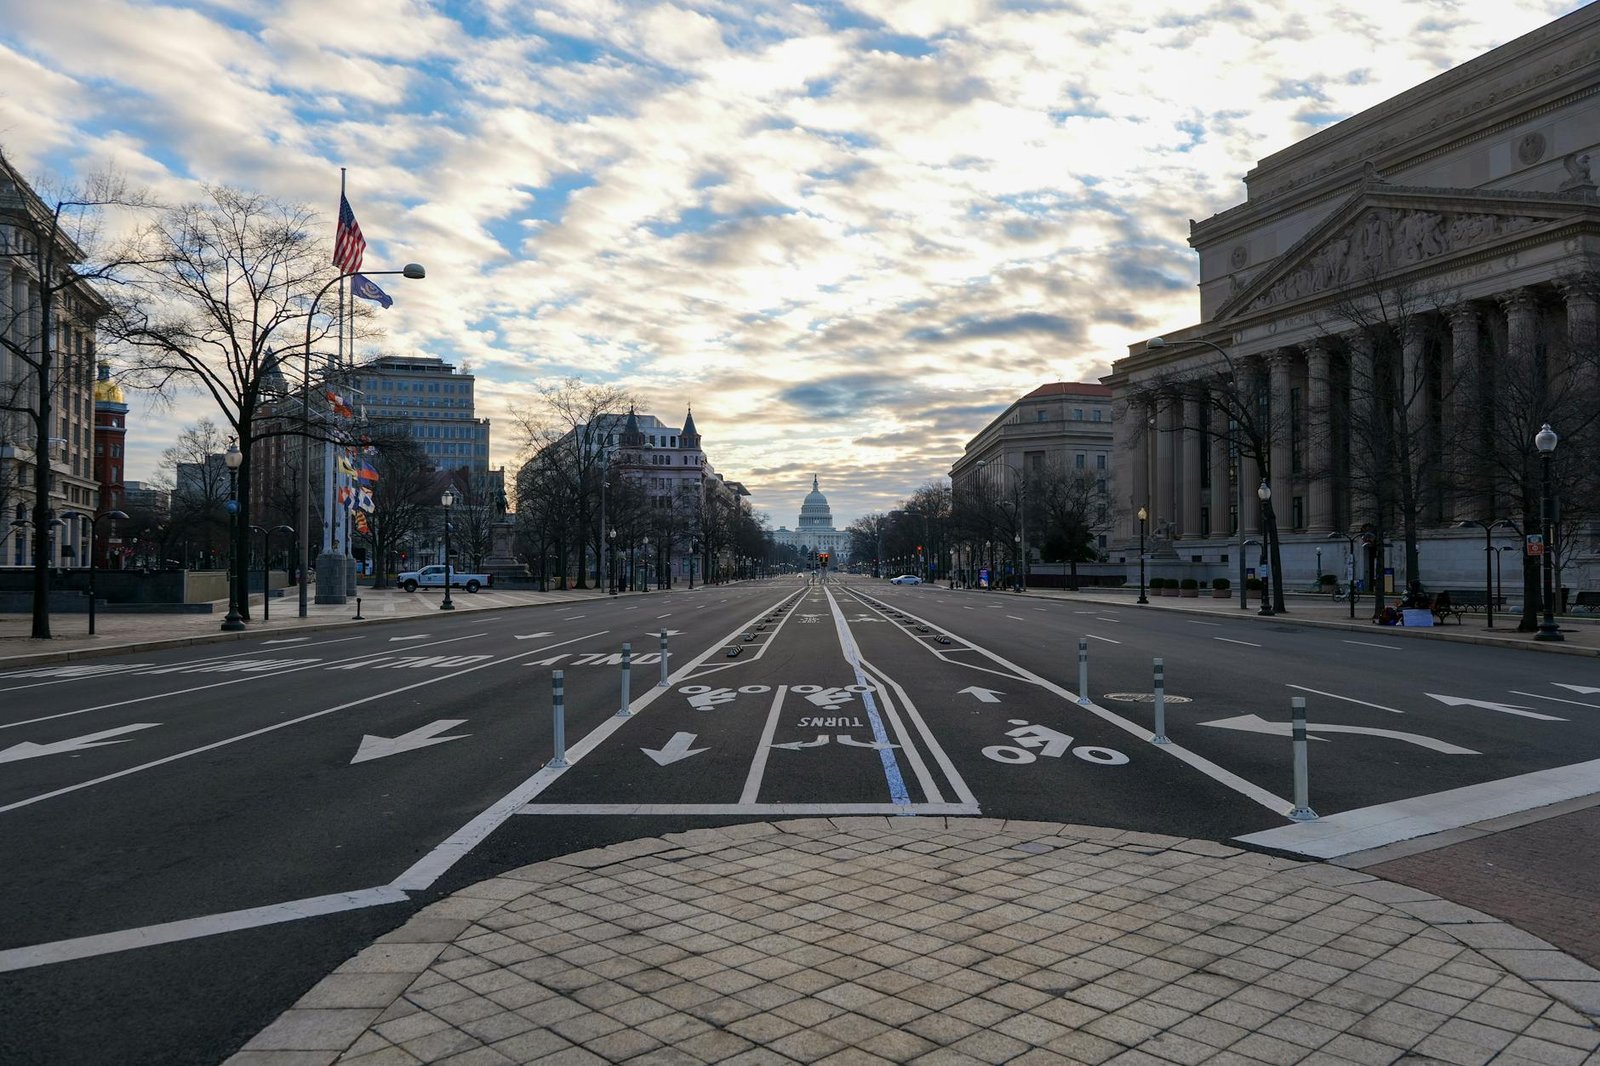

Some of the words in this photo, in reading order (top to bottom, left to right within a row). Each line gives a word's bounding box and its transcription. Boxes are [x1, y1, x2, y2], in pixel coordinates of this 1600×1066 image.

[1443, 263, 1494, 286] AMERICA
[324, 655, 495, 669] ONLY
[522, 653, 673, 666] ONLY
[797, 716, 863, 728] TURNS
